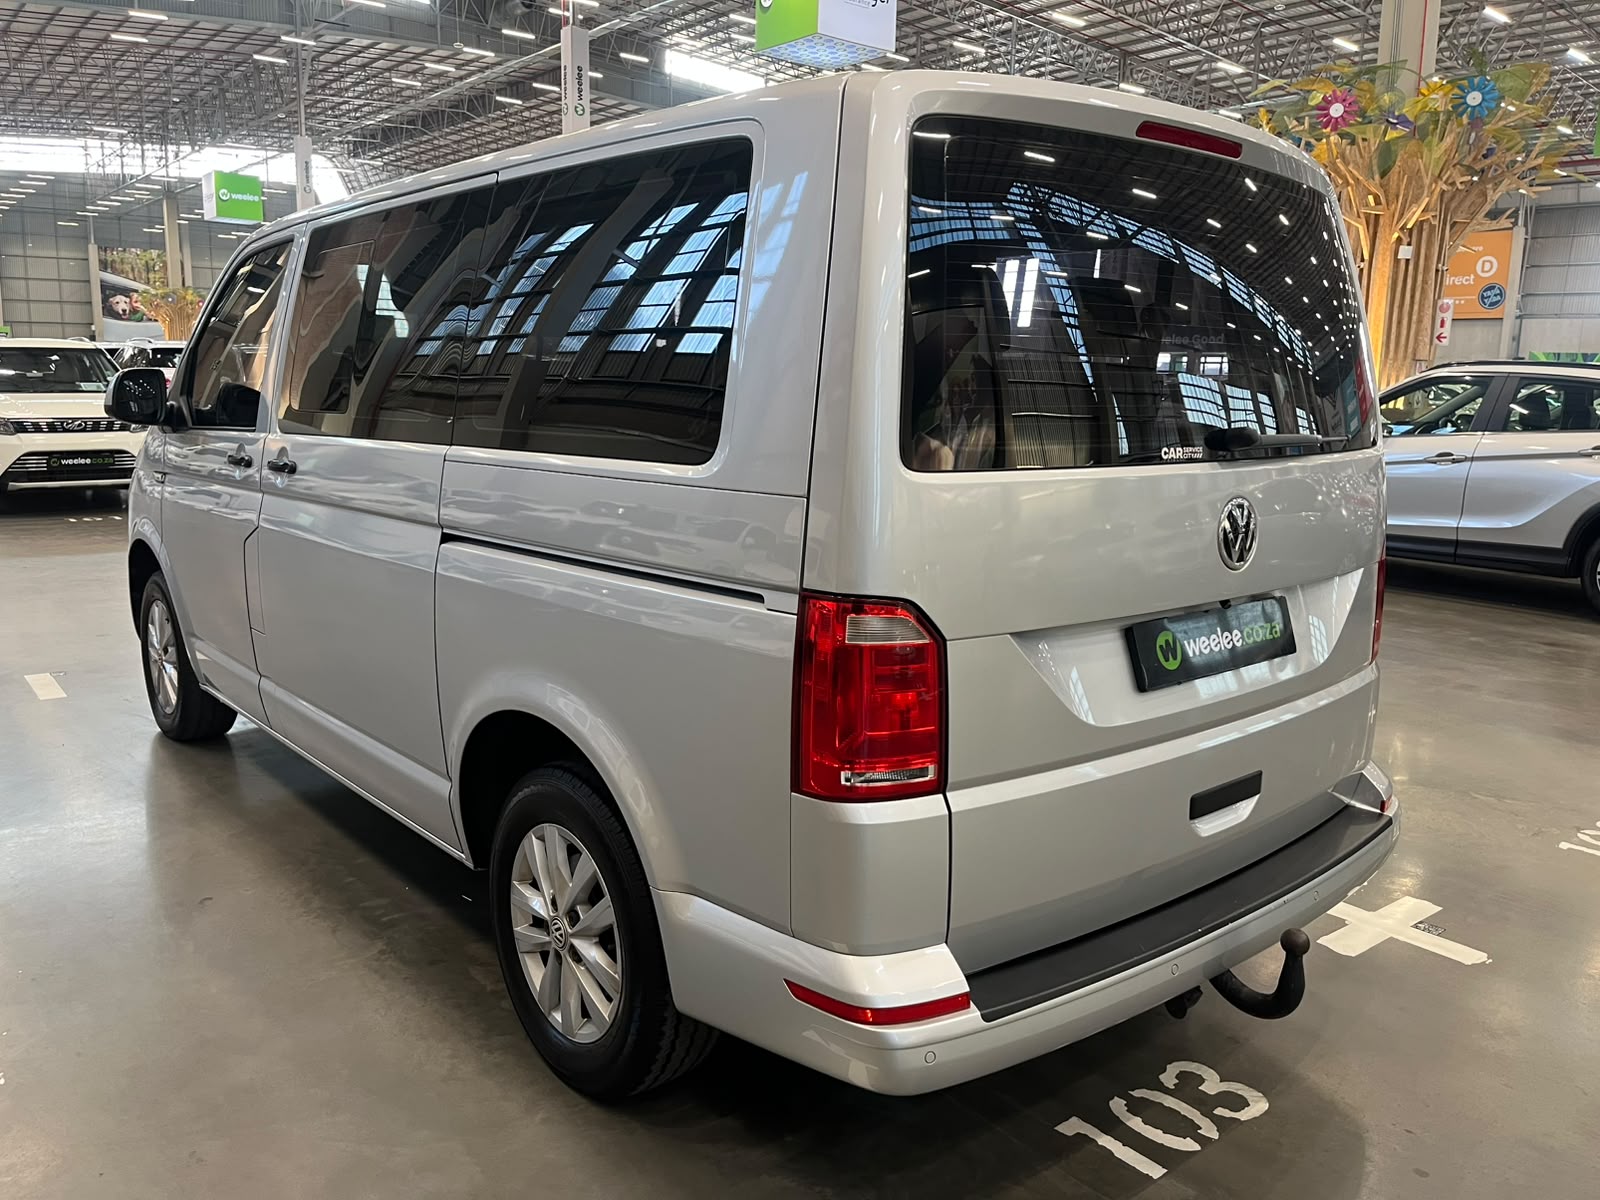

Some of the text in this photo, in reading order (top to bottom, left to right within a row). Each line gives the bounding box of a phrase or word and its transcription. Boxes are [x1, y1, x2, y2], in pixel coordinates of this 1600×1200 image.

[230, 193, 259, 202] weelee
[1446, 274, 1475, 285] irect
[1161, 447, 1183, 460] CAR
[1183, 622, 1281, 658] weelee.co.za
[1053, 1060, 1269, 1180] 103
